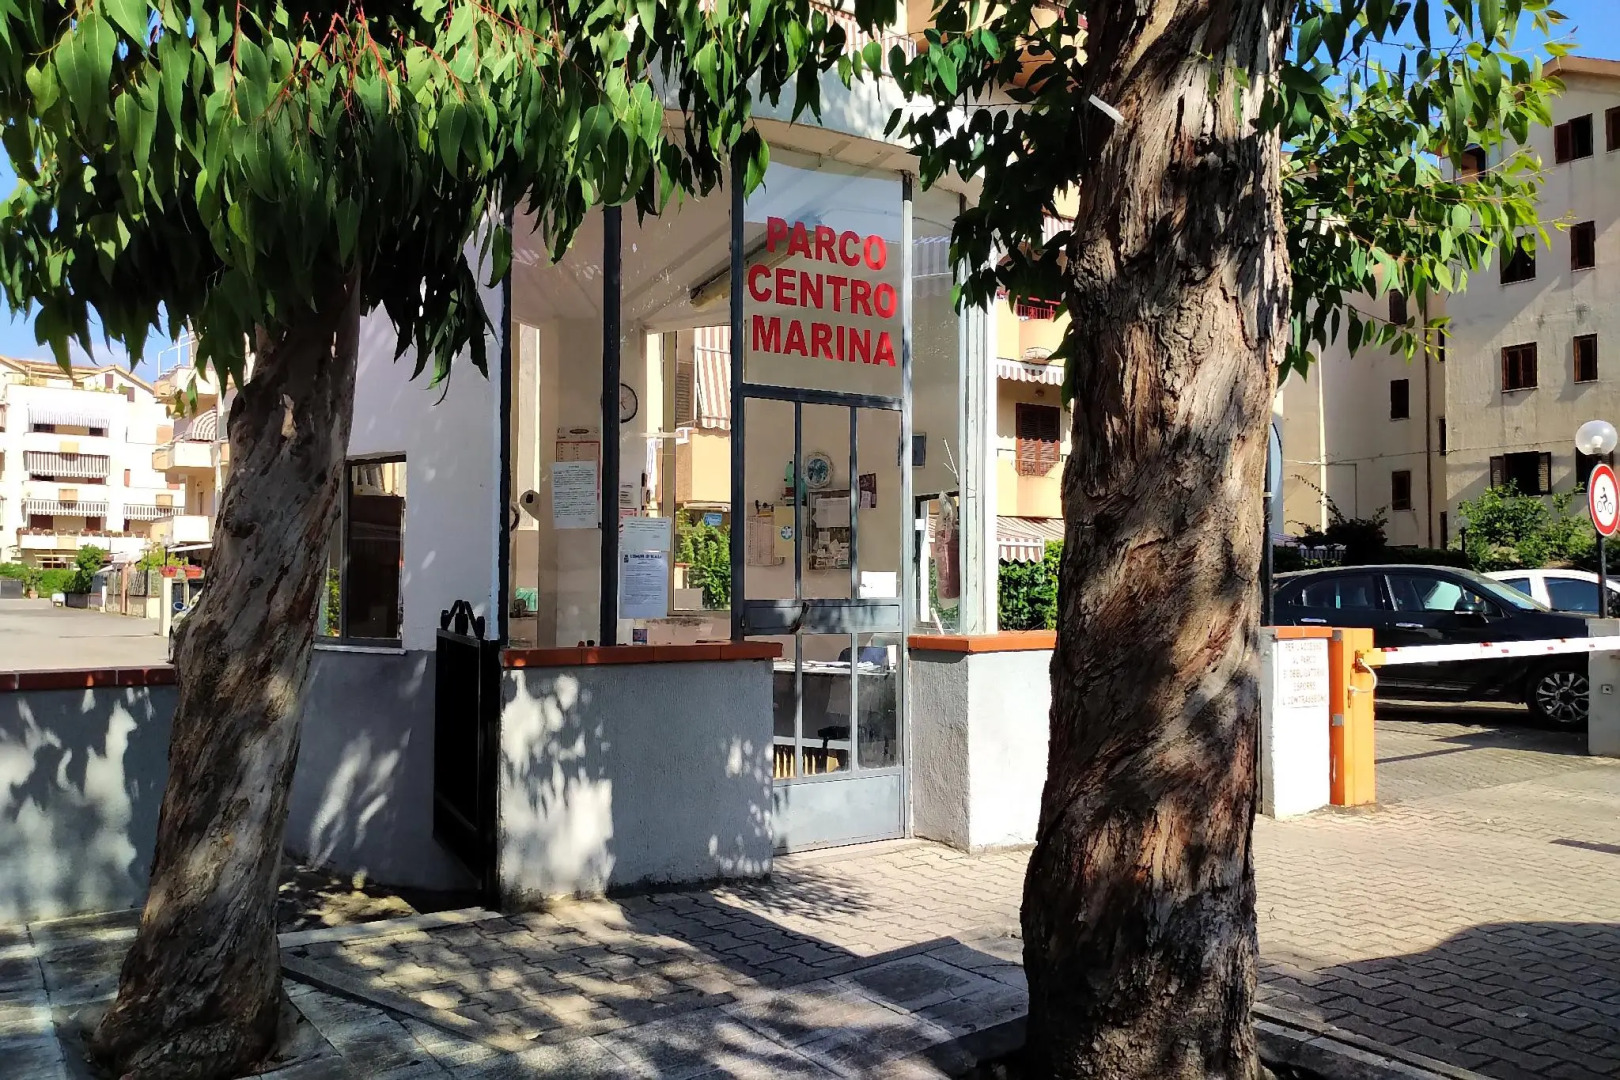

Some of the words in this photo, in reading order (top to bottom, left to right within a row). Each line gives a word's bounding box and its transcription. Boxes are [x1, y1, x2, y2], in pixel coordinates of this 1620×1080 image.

[767, 217, 888, 272] PARCO
[748, 264, 898, 320] CENTRO
[752, 314, 897, 368] MARINA
